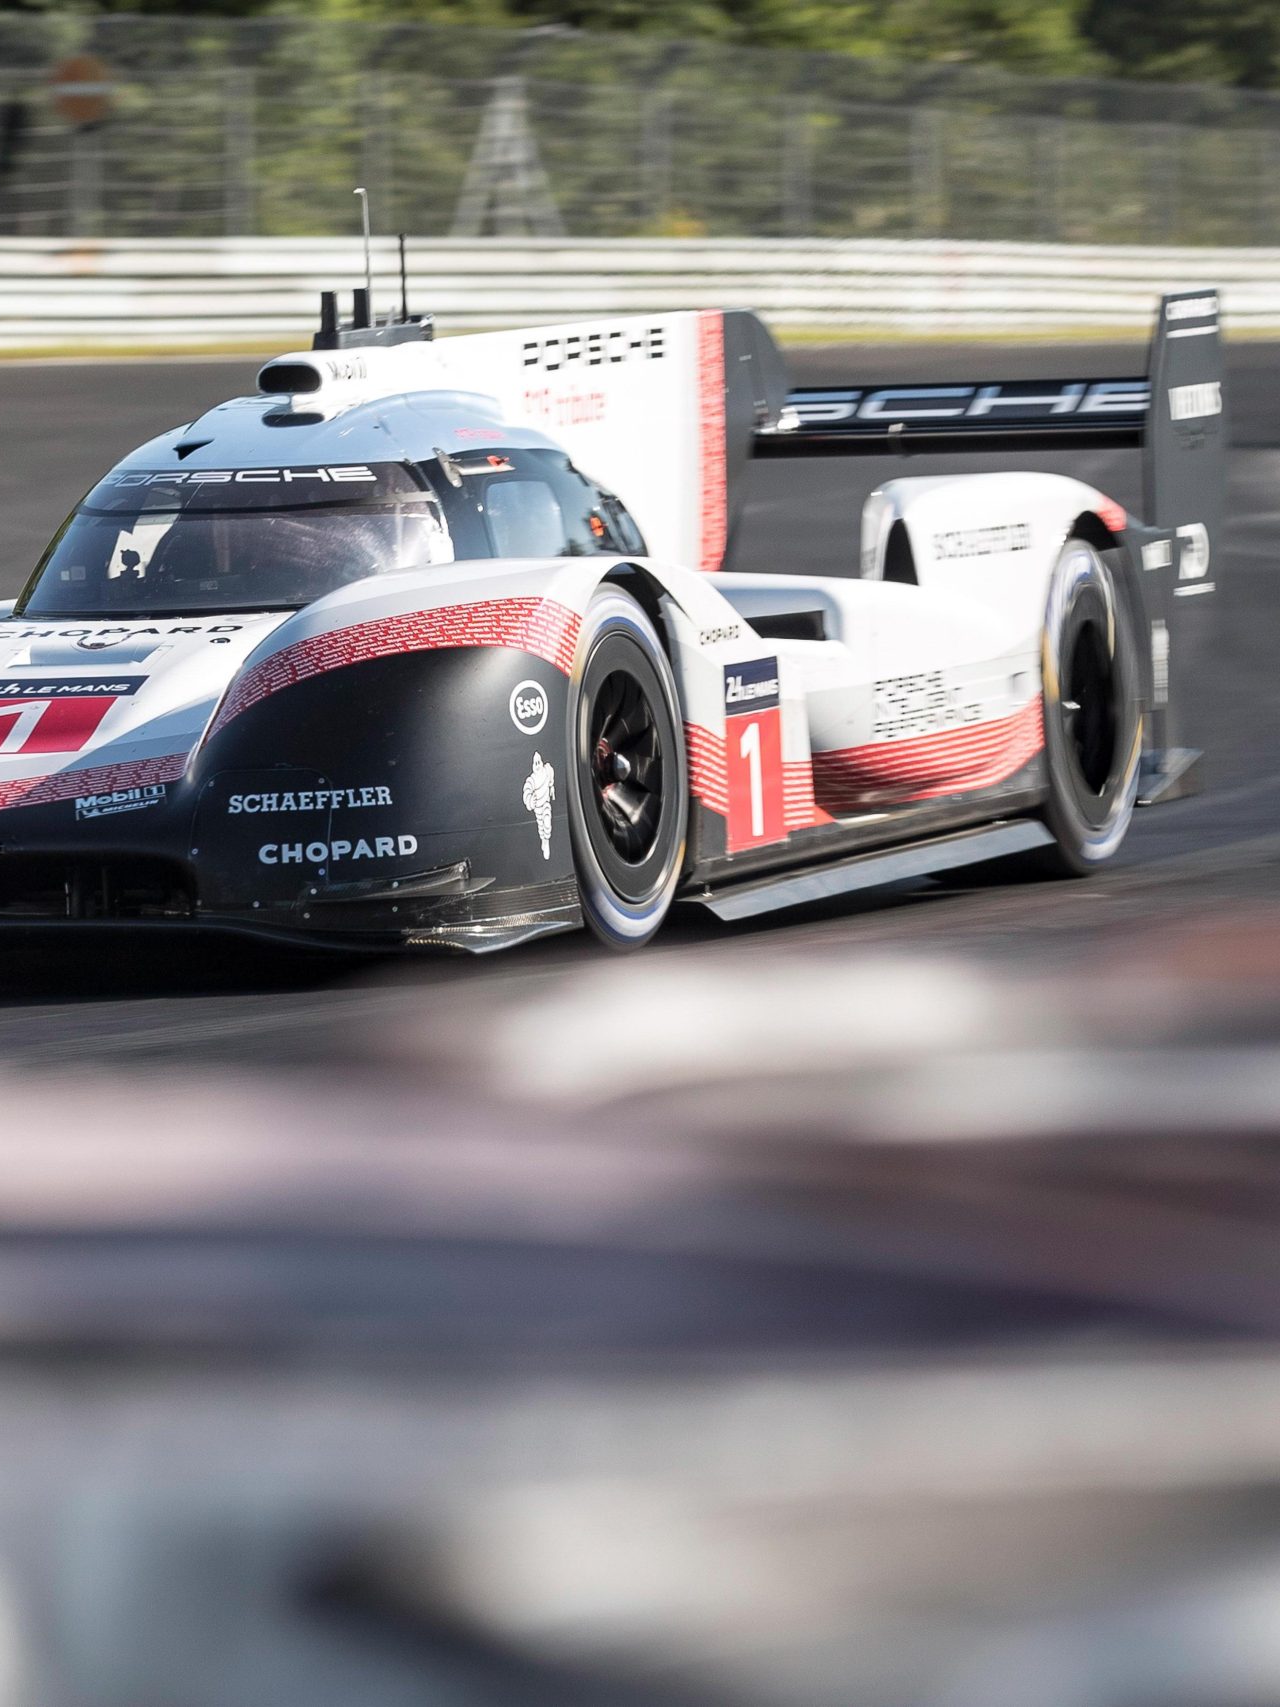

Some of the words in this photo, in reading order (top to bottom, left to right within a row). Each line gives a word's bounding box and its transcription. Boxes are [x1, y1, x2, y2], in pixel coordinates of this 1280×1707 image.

[22, 686, 44, 695] LE
[56, 683, 131, 693] MANS
[739, 722, 764, 838] 1
[75, 788, 141, 809] Mobil
[101, 799, 159, 812] MICHELIN
[227, 786, 393, 815] SCHAEFFLER
[258, 834, 419, 865] CHOPARD
